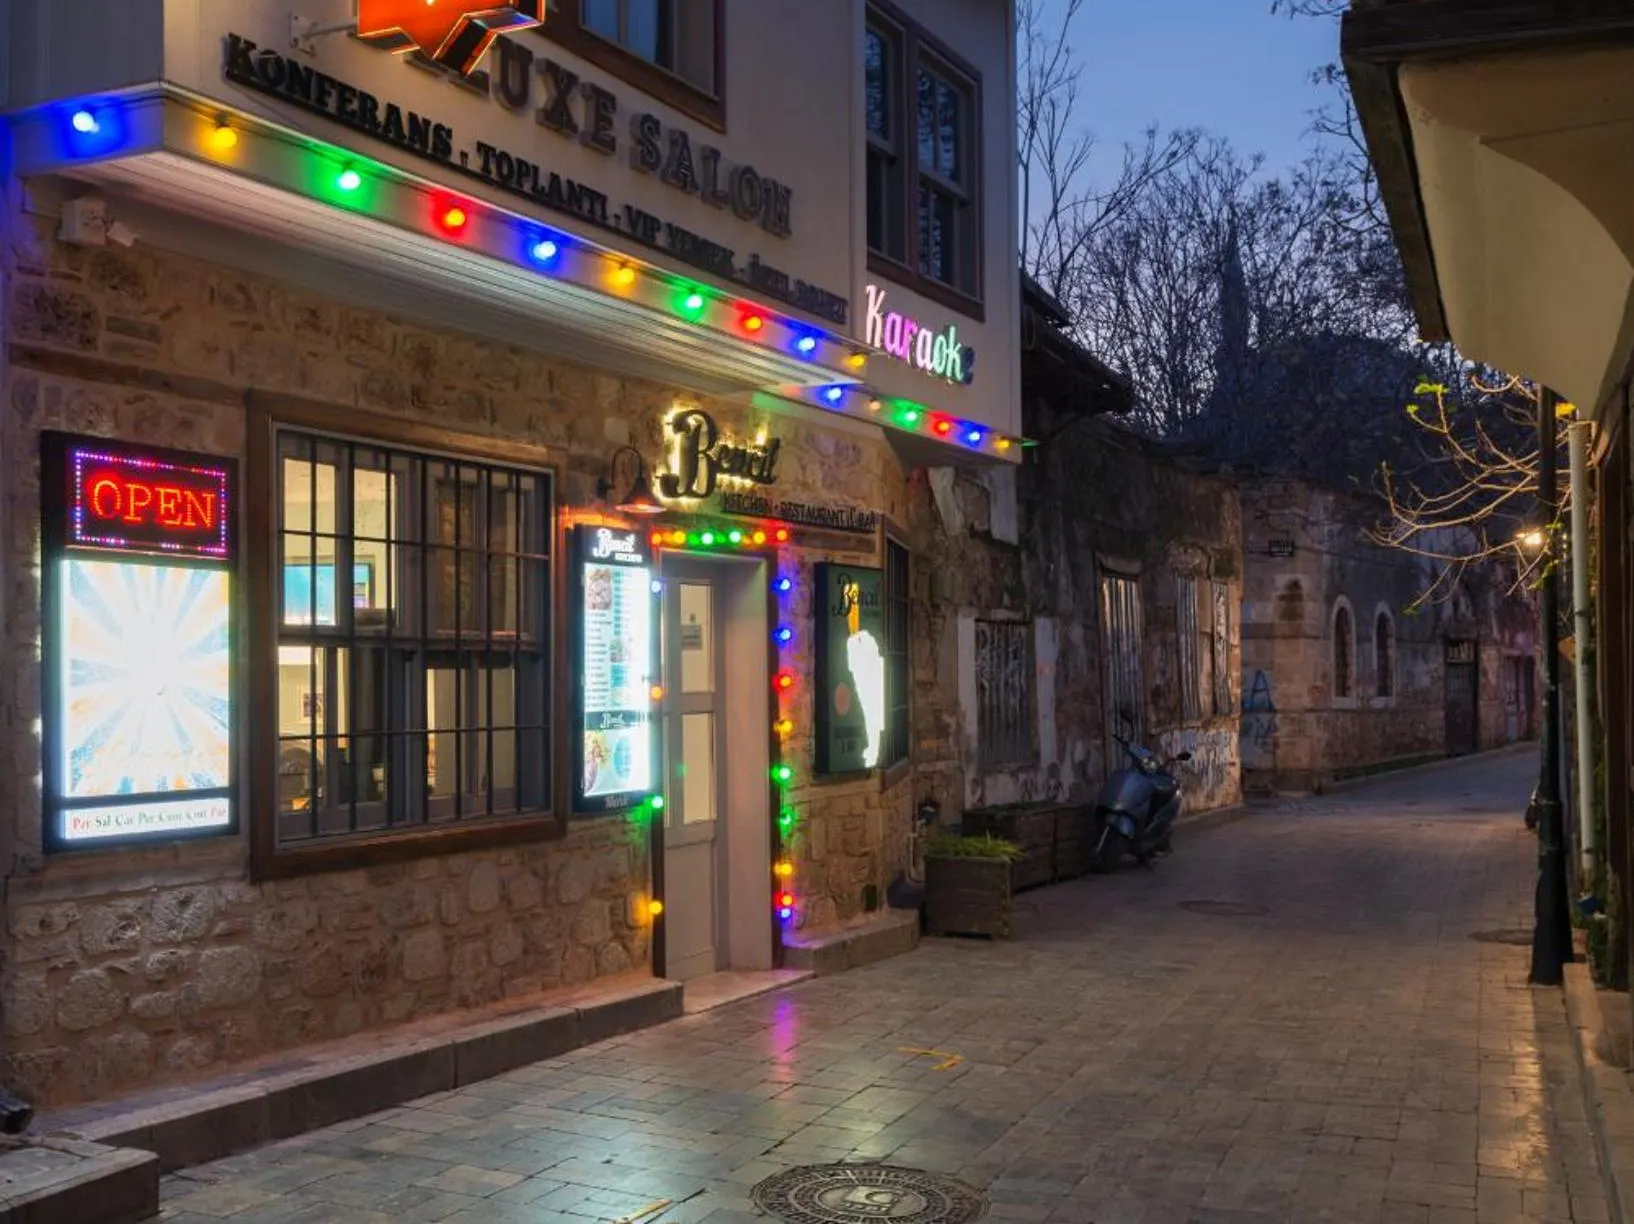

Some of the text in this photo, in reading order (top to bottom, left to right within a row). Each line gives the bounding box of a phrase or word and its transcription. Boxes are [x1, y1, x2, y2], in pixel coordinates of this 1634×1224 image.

[629, 112, 793, 239] SALON
[622, 204, 661, 244] VIP
[865, 284, 975, 385] Karaoke
[93, 479, 216, 529] OPEN
